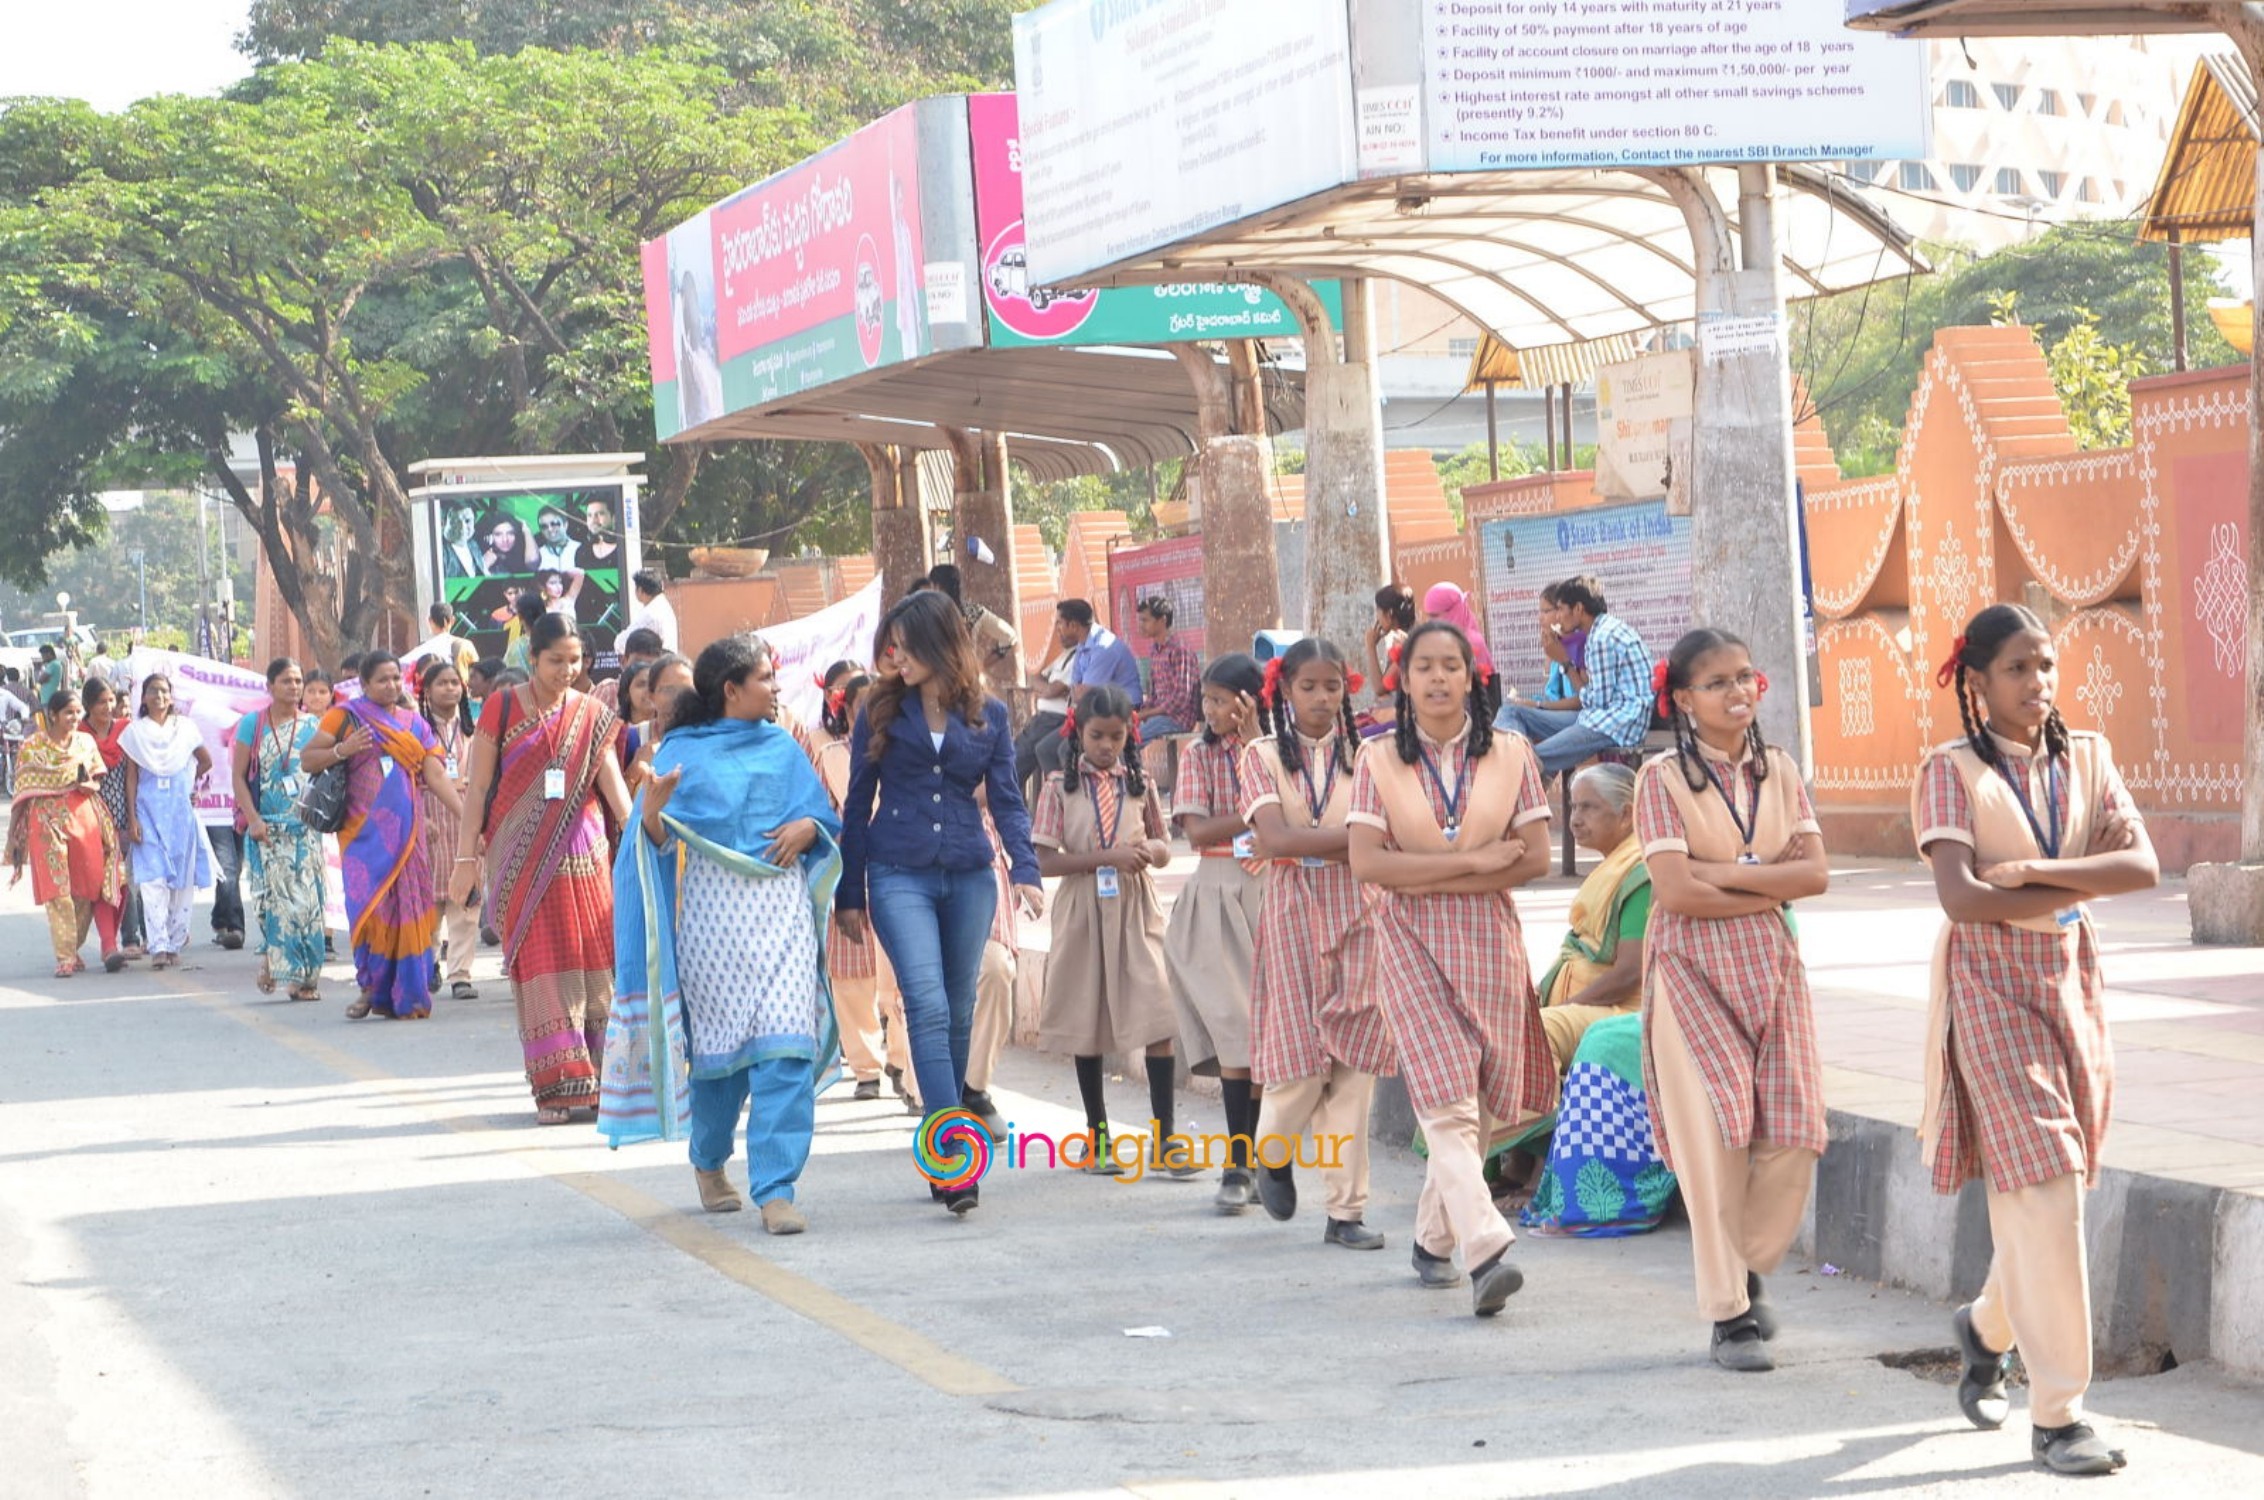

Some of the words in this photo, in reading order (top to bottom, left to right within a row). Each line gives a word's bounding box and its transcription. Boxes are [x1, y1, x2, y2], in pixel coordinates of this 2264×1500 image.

[1450, 2, 1502, 18] Deposit
[1506, 2, 1524, 14] for
[1528, 1, 1558, 17] only
[1563, 1, 1577, 13] 14
[1580, 4, 1617, 17] years
[1620, 1, 1649, 13] with
[1652, 0, 1707, 14] maturity
[1711, 0, 1723, 11] at
[1727, 0, 1741, 11] 21
[1745, 1, 1782, 14] years
[1452, 25, 1500, 39] Facility
[1504, 24, 1518, 35] of
[1521, 24, 1550, 35] 50%
[1553, 24, 1610, 38] payment
[1614, 22, 1644, 34] after
[1650, 22, 1664, 33] 18
[1667, 24, 1703, 37] years
[1706, 21, 1720, 32] of
[1724, 23, 1748, 36] age
[1452, 46, 1498, 61] Facility
[1501, 45, 1515, 57] of
[1517, 46, 1569, 57] account
[1571, 45, 1619, 57] closure
[1622, 47, 1639, 55] on
[1641, 45, 1697, 58] marriage
[1700, 42, 1728, 54] after
[1731, 42, 1751, 54] the
[1754, 44, 1778, 57] age
[1780, 40, 1793, 53] of
[1797, 41, 1811, 53] 18
[1820, 43, 1855, 56] years
[1453, 68, 1505, 84] Deposit
[1508, 69, 1572, 79] minimum
[1625, 65, 1651, 78] and
[1653, 67, 1719, 77] maximum
[1794, 65, 1815, 78] per
[1822, 64, 1850, 78] year
[1454, 91, 1507, 105] Highest
[1510, 90, 1561, 102] interest
[1564, 90, 1590, 101] rate
[1593, 89, 1652, 104] amongst
[1655, 87, 1671, 100] all
[1674, 87, 1709, 99] other
[1712, 85, 1749, 98] small
[1752, 85, 1803, 99] savings
[1806, 85, 1865, 96] schemes
[1457, 107, 1523, 123] (presently
[1528, 106, 1566, 121] 9.2%)
[1459, 130, 1509, 142] Income
[1514, 128, 1536, 141] Tax
[1539, 127, 1586, 140] benefit
[1589, 127, 1627, 139] under
[1632, 126, 1681, 138] section
[1684, 125, 1700, 137] 80
[1703, 124, 1719, 136] C.
[1480, 151, 1502, 164] For
[1504, 153, 1538, 163] more
[1541, 150, 1618, 164] information,
[1621, 148, 1671, 161] Contact
[1673, 148, 1694, 160] the
[1697, 147, 1744, 159] nearest
[1747, 145, 1770, 157] SBI
[1772, 145, 1818, 157] Branch
[1820, 144, 1873, 157] Manager
[1571, 522, 1597, 547] State
[1600, 519, 1627, 543] Bank
